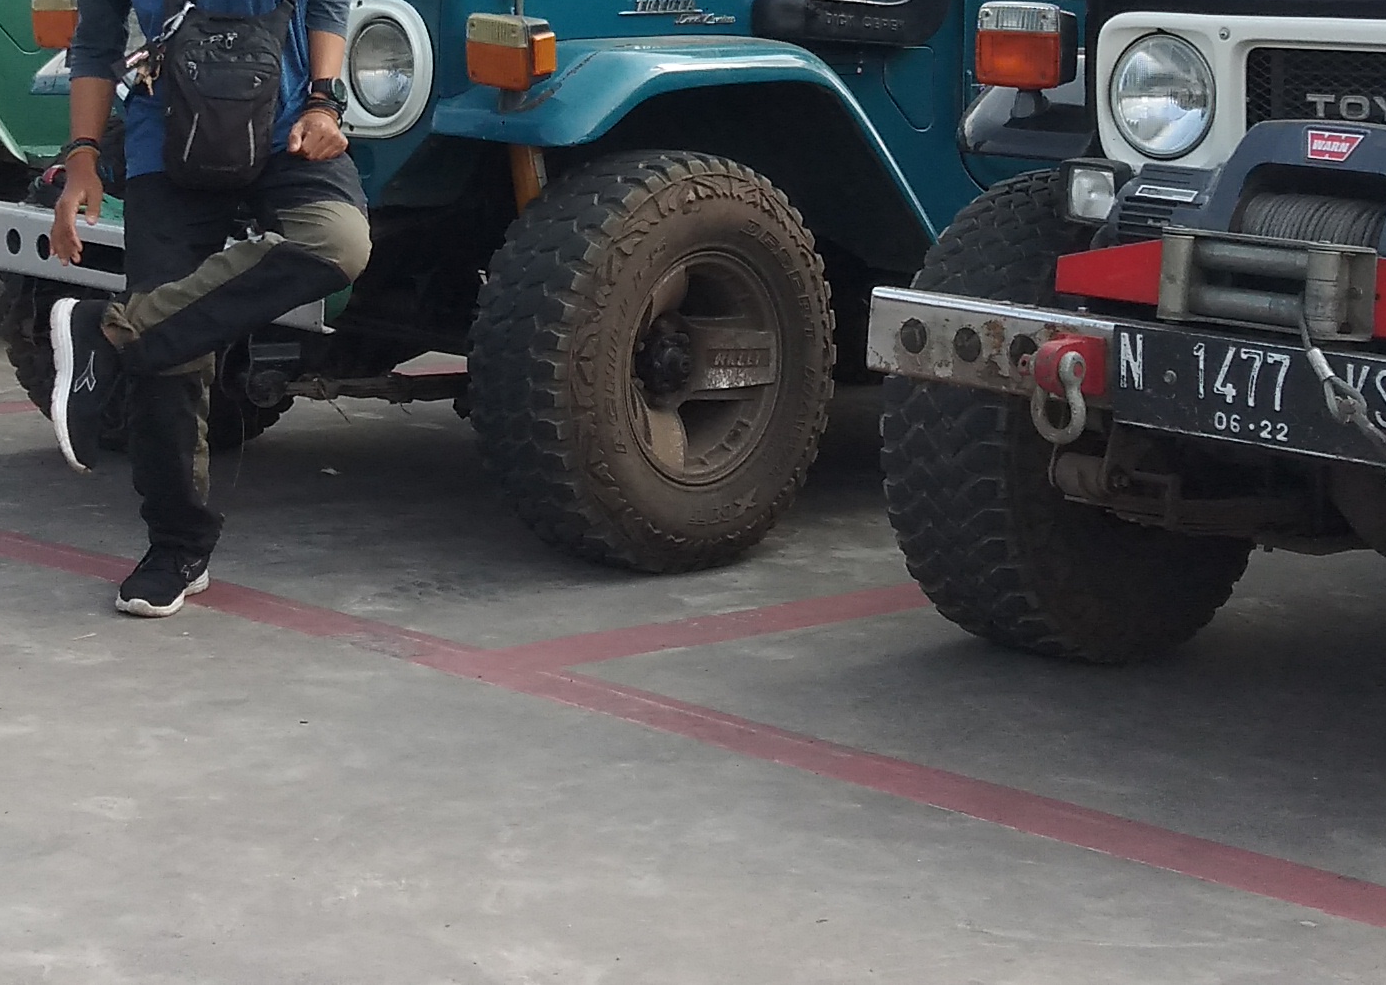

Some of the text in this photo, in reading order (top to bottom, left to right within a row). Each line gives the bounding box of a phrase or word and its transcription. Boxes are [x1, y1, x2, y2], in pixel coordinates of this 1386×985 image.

[1311, 138, 1351, 154] WARN
[1120, 332, 1144, 391] N
[1192, 341, 1291, 412] 1477
